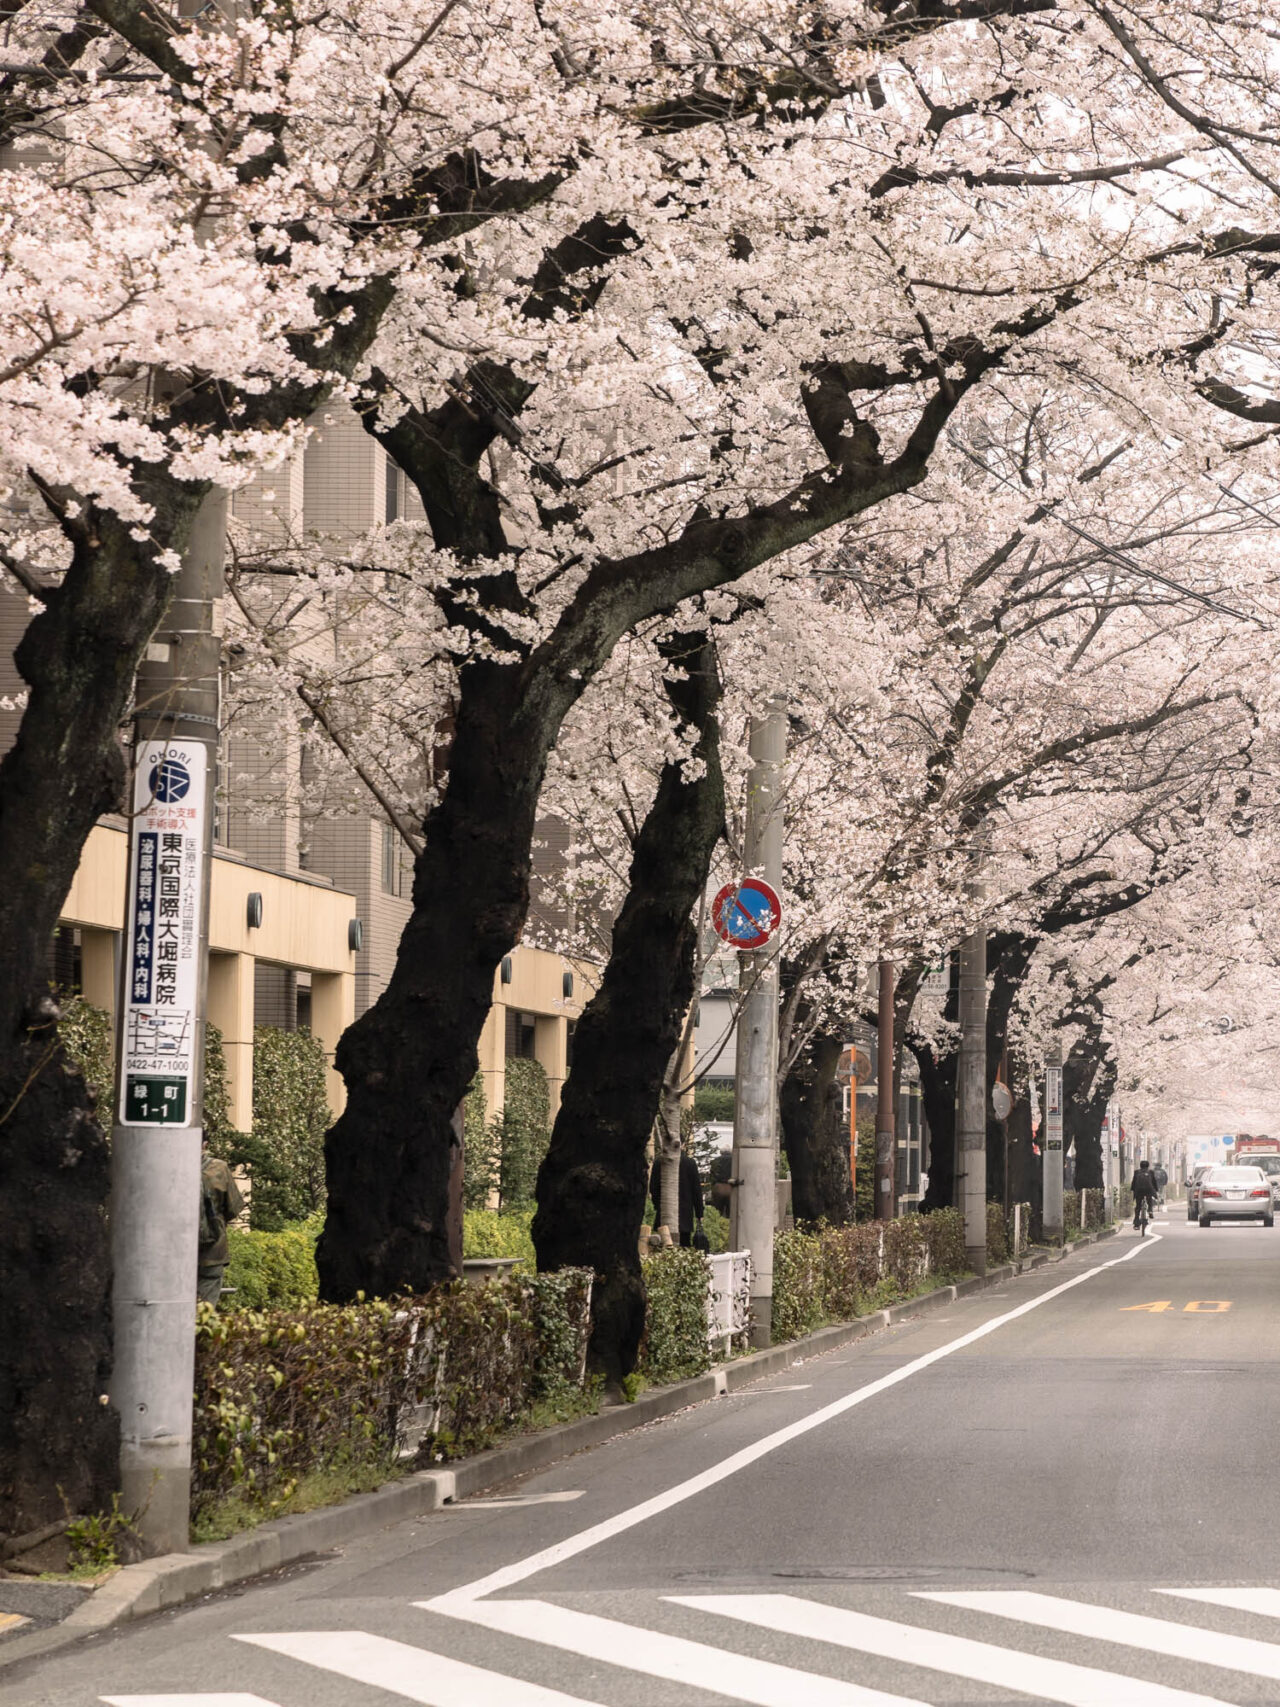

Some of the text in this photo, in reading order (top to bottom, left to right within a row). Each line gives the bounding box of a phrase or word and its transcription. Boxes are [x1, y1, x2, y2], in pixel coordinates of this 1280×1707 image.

[147, 818, 189, 831] 手術導入
[155, 832, 182, 1006] 東京国際大堀病院
[127, 1058, 189, 1072] 0422-47-1000
[140, 1103, 168, 1117] 1-1
[1119, 1300, 1233, 1313] 40
